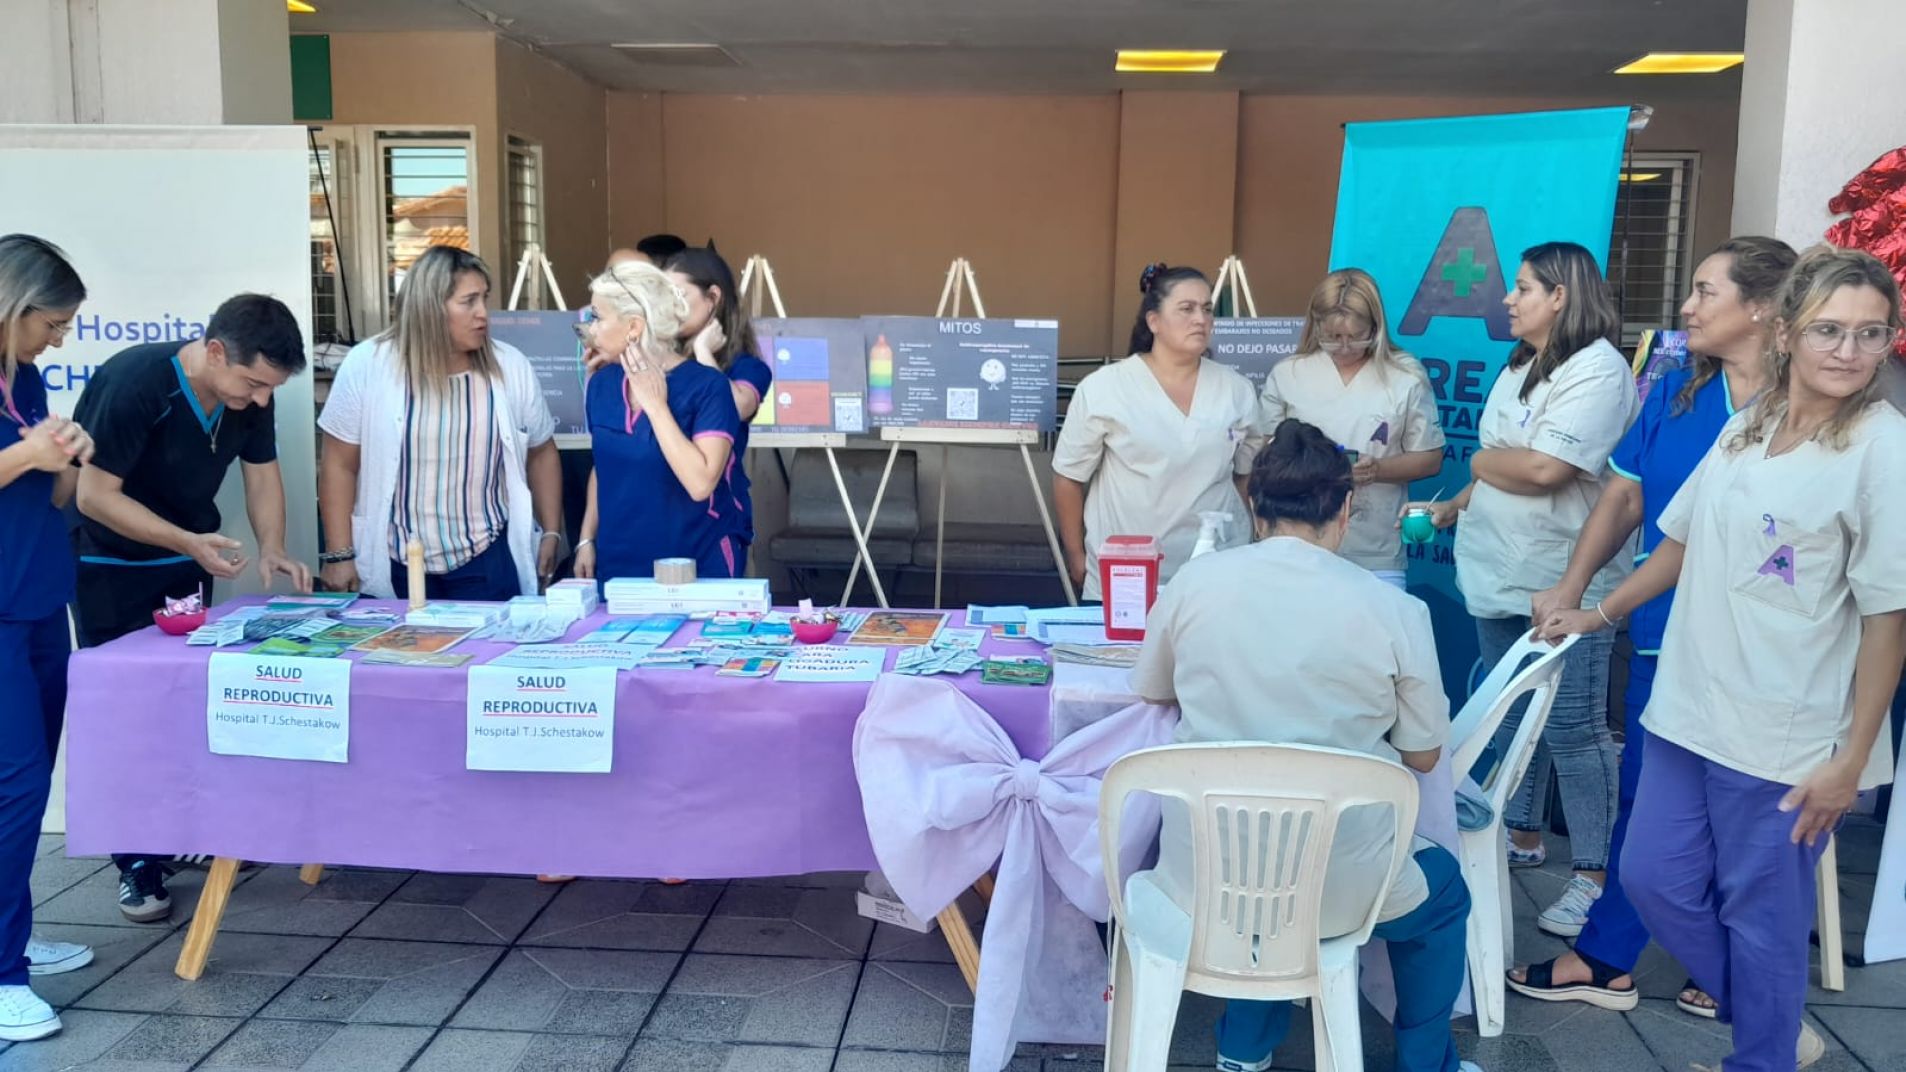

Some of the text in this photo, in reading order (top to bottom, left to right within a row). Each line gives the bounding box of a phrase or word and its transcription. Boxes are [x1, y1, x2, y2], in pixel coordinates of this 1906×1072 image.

[77, 313, 206, 344] Hospita
[939, 321, 982, 335] MITOS
[1218, 344, 1234, 354] NO
[1237, 344, 1263, 354] DEJO
[256, 665, 303, 680] SALUD
[516, 675, 566, 689] SALUD
[224, 687, 334, 706] REPRODUCTIVA
[483, 700, 598, 714] REPRODUCTIVA
[216, 712, 259, 725] Hospital
[474, 726, 519, 738] Hospital
